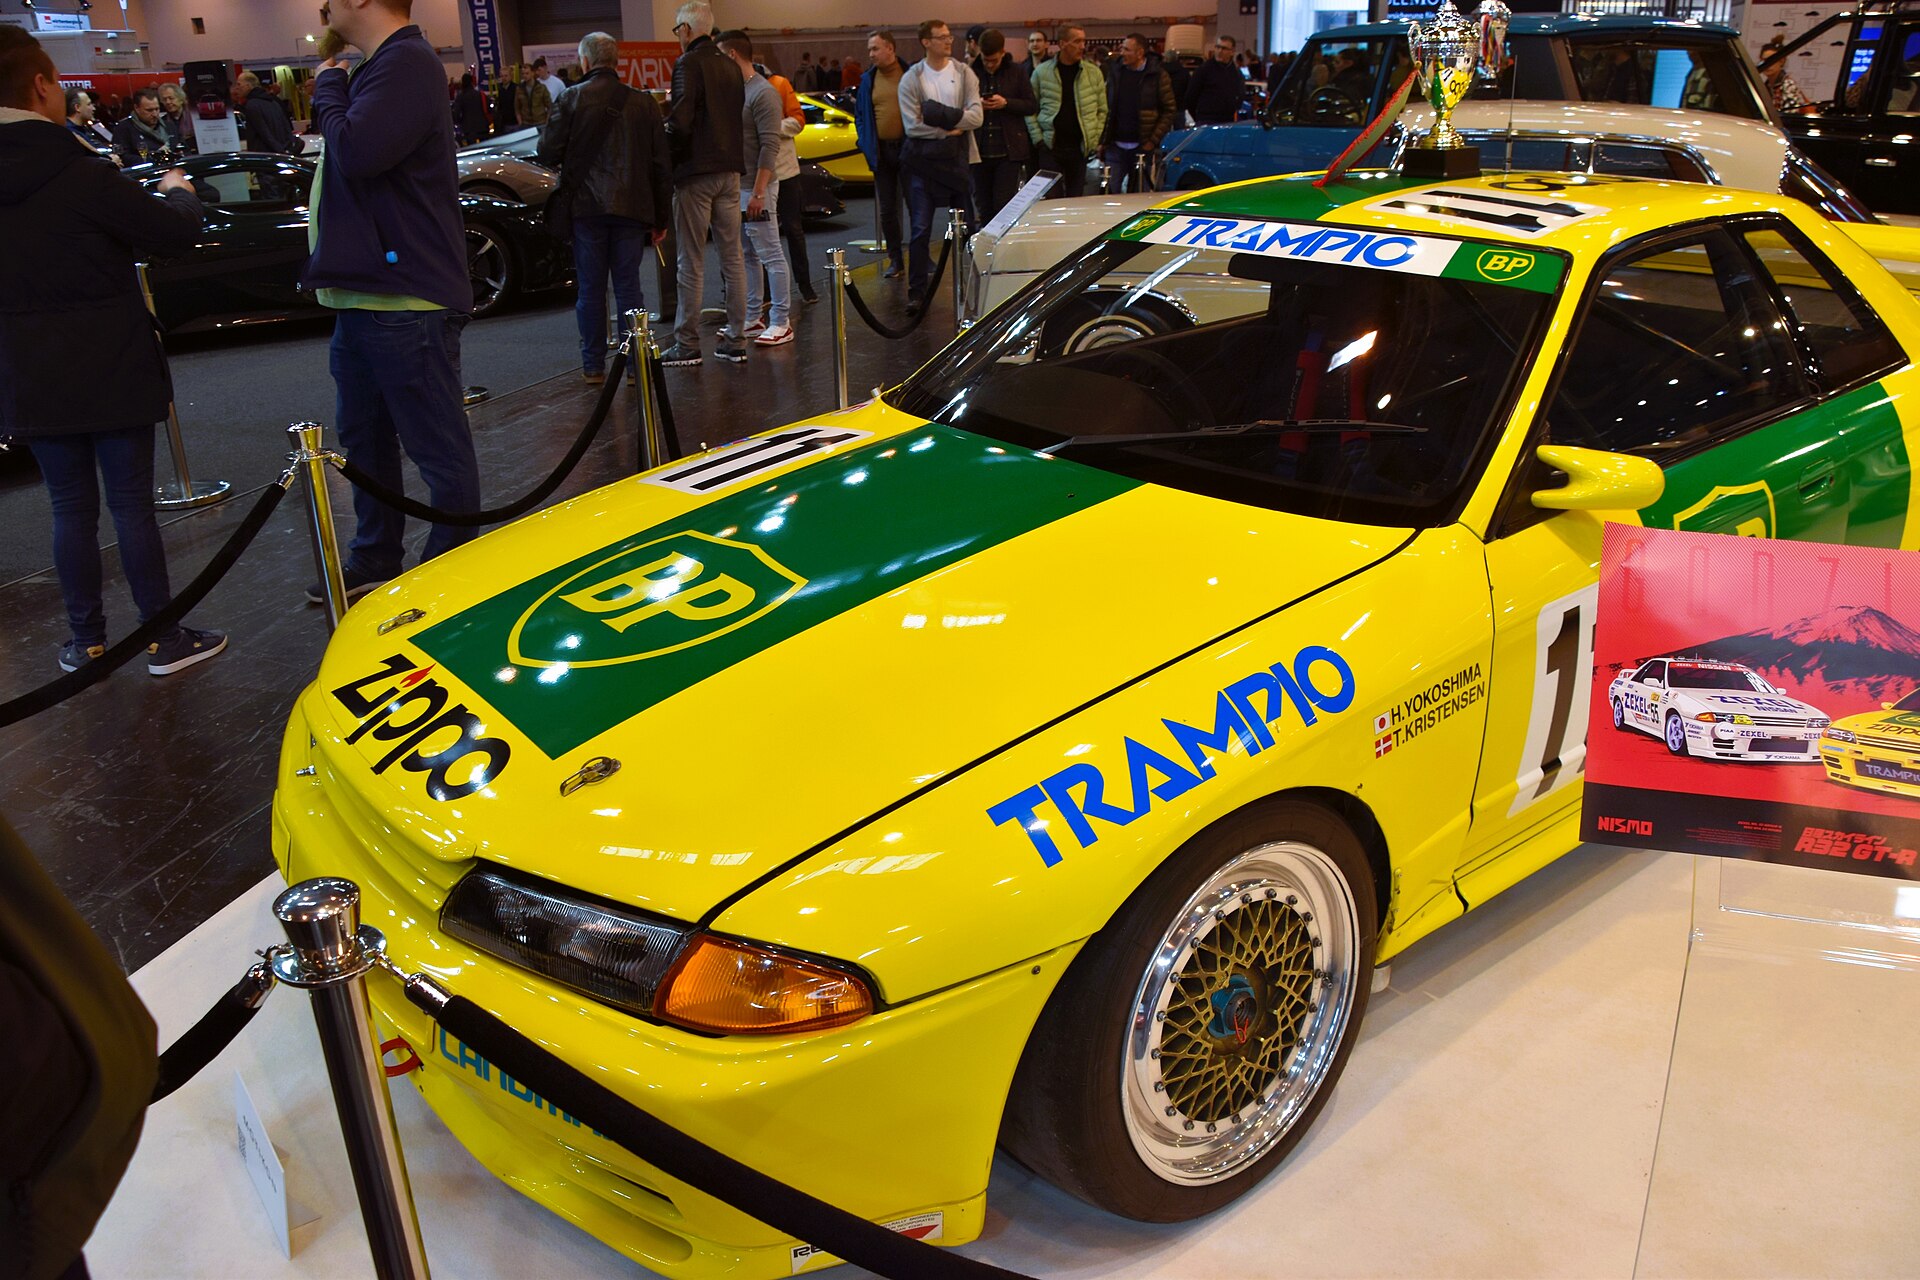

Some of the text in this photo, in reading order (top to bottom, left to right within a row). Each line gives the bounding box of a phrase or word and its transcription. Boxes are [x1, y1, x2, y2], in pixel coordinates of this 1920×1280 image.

[1380, 189, 1585, 233] 11
[1168, 217, 1418, 267] TRAMPIO
[1483, 255, 1530, 273] BP
[659, 428, 861, 491] 11
[558, 551, 756, 634] BP
[1391, 662, 1481, 726] H.YOKOSHIMA
[1392, 681, 1485, 747] T.KRISTENSEN
[1532, 604, 1597, 800] 1
[1624, 692, 1649, 715] ZEXEL
[1650, 702, 1660, 724] 55
[985, 645, 1356, 868] TRAMPIO
[1740, 730, 1767, 738] ZEXEL
[1597, 815, 1653, 837] NISMO
[1793, 836, 1851, 858] R32
[1852, 843, 1918, 866] GT-R
